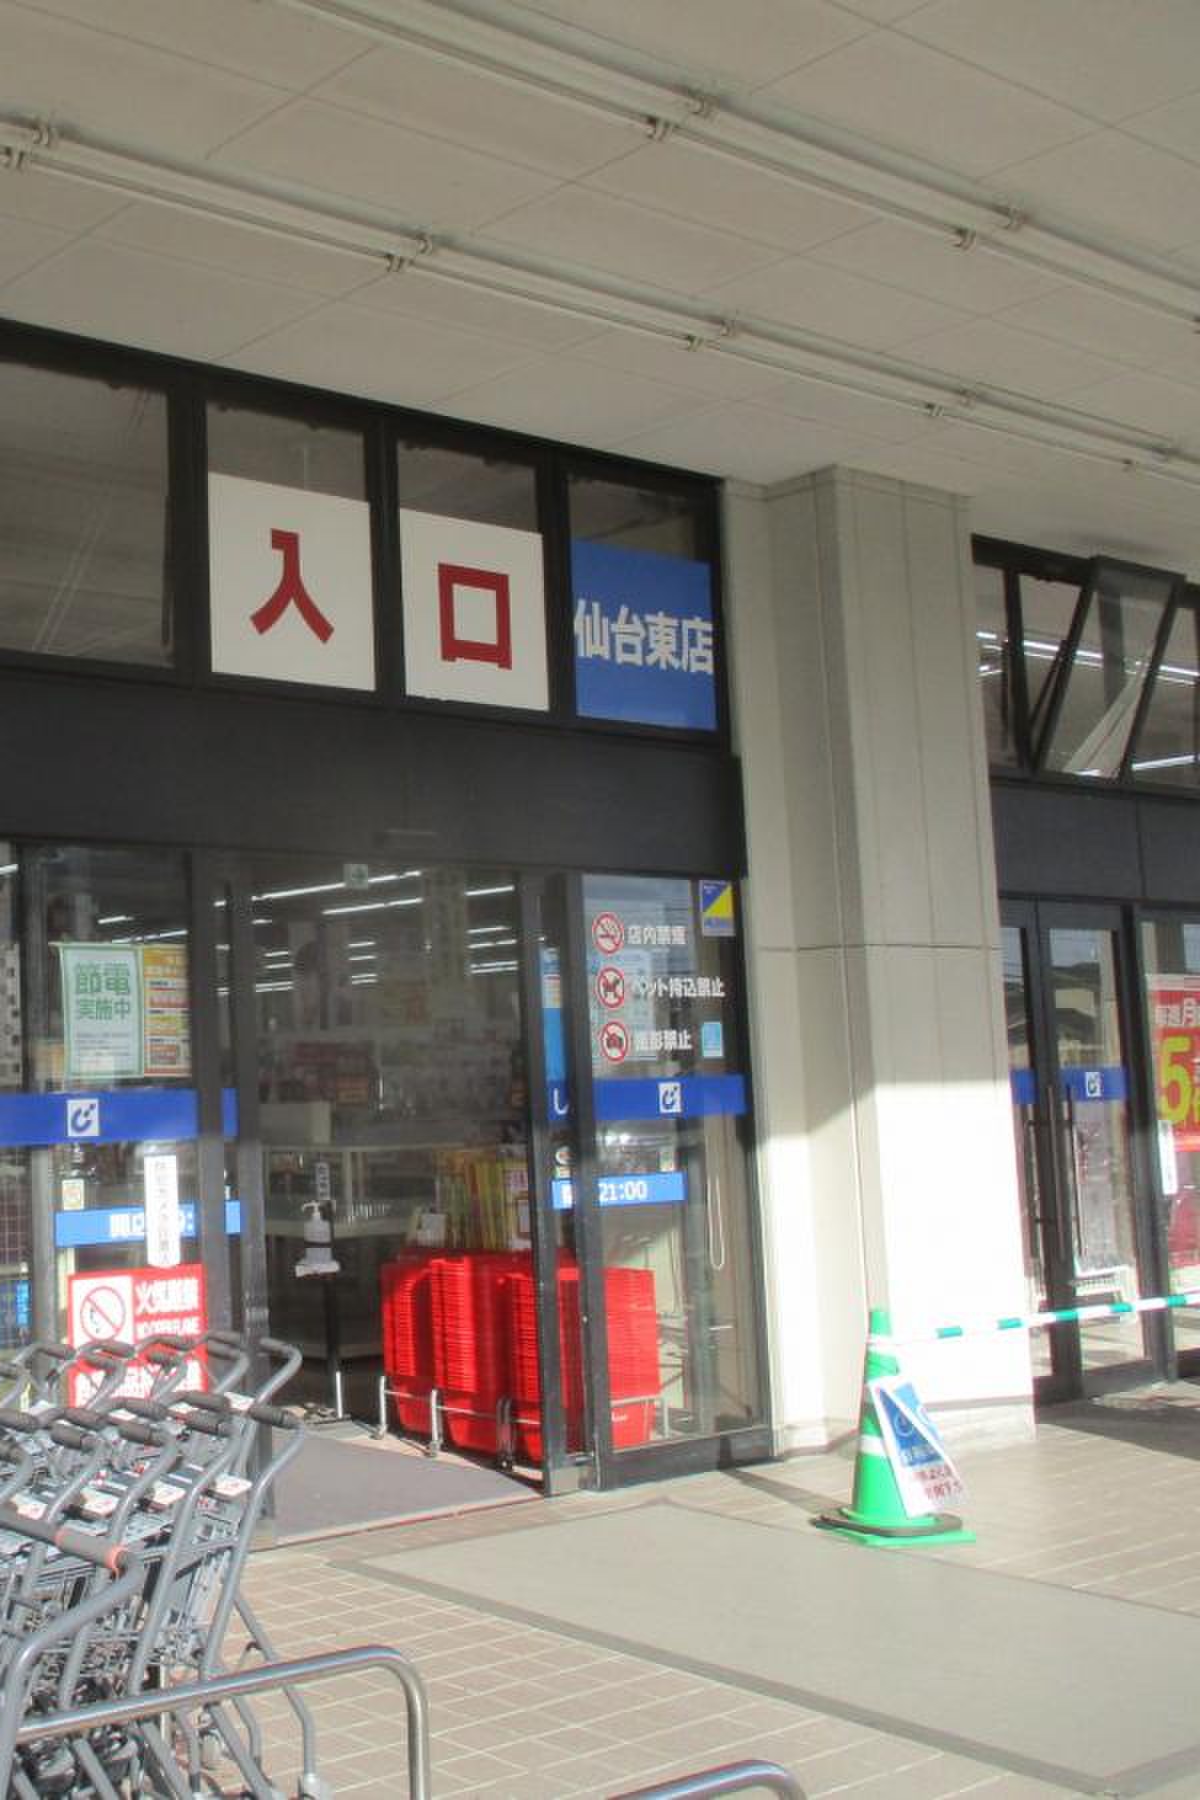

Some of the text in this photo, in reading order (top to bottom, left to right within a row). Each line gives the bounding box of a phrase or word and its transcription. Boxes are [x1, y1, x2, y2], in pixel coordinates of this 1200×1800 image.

[573, 600, 714, 676] 仙台東店
[598, 1179, 648, 1201] 21:00
